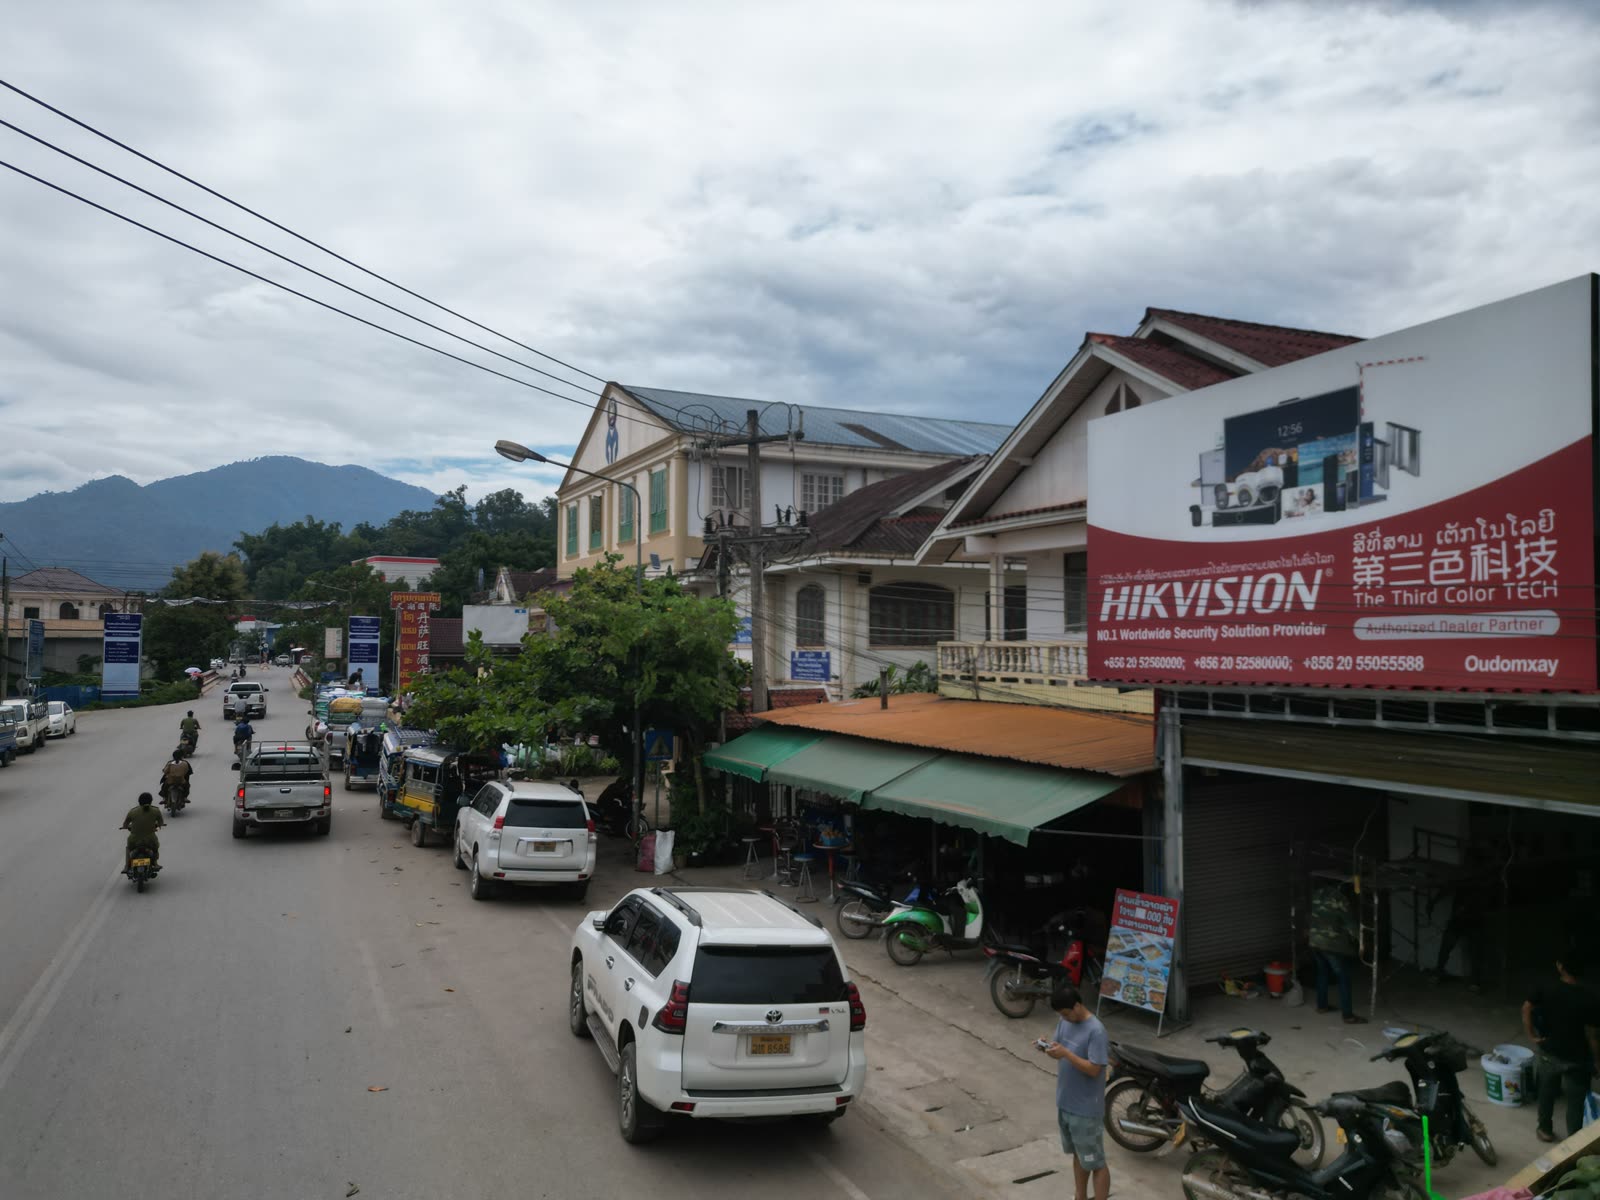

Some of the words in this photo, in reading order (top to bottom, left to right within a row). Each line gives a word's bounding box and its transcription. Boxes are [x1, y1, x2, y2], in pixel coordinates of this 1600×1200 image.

[1277, 423, 1303, 437] 12:56
[1352, 536, 1559, 590] 第三色科技
[1100, 568, 1323, 622] HIKVISION
[1353, 592, 1385, 608] The
[1391, 588, 1438, 606] Third
[1444, 585, 1496, 603] Color
[1503, 580, 1558, 600] TECH
[1120, 627, 1171, 640] Worldwide
[1174, 625, 1219, 642] Security
[1221, 624, 1270, 639] Solution
[1273, 623, 1327, 636] Provider
[1366, 620, 1435, 635] Authorized
[1439, 618, 1484, 633] Dealer
[1489, 617, 1544, 632] Partner
[1126, 657, 1137, 669] 20
[1194, 657, 1219, 669] +856
[1221, 657, 1234, 669] 20
[1303, 655, 1334, 670] +856
[1336, 656, 1352, 670] 20
[1356, 655, 1424, 671] 55055588
[1464, 655, 1559, 677] Oudomxay
